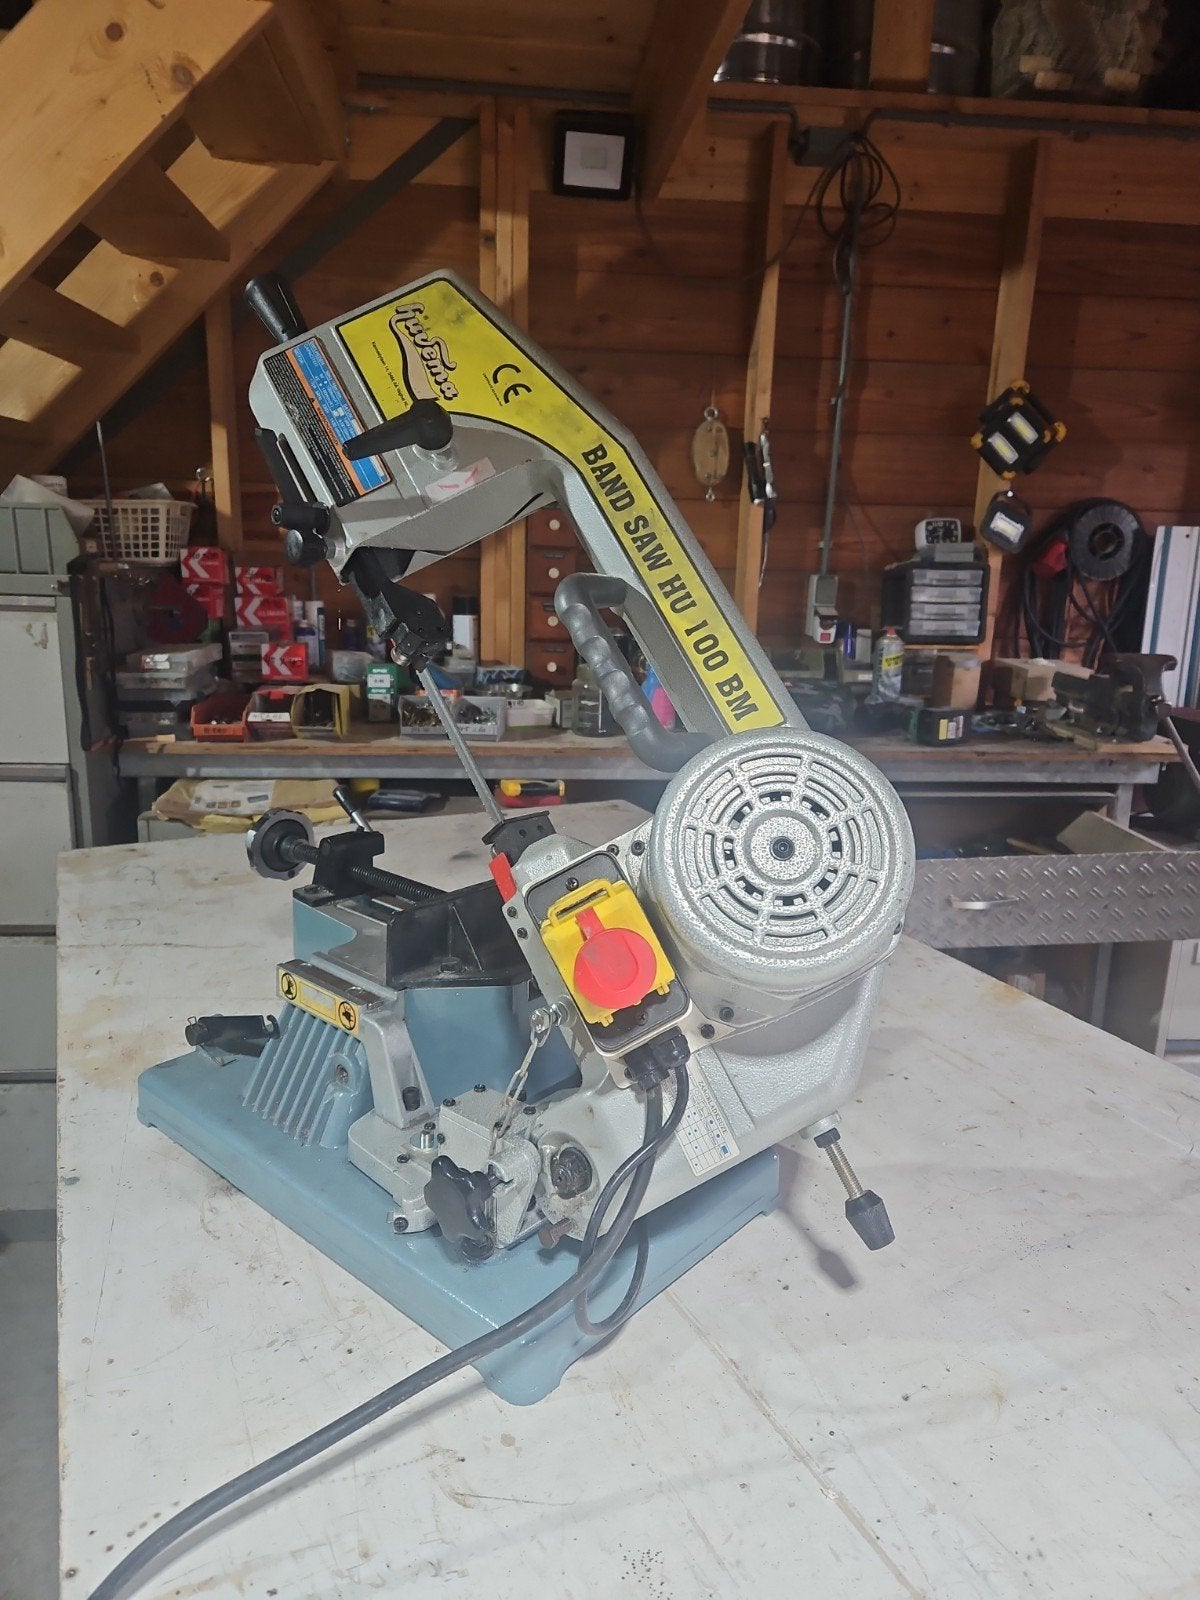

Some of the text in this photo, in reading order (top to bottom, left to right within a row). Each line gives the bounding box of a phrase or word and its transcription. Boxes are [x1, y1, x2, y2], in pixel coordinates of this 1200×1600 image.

[582, 444, 759, 721] BAND SAW HU 100 BM
